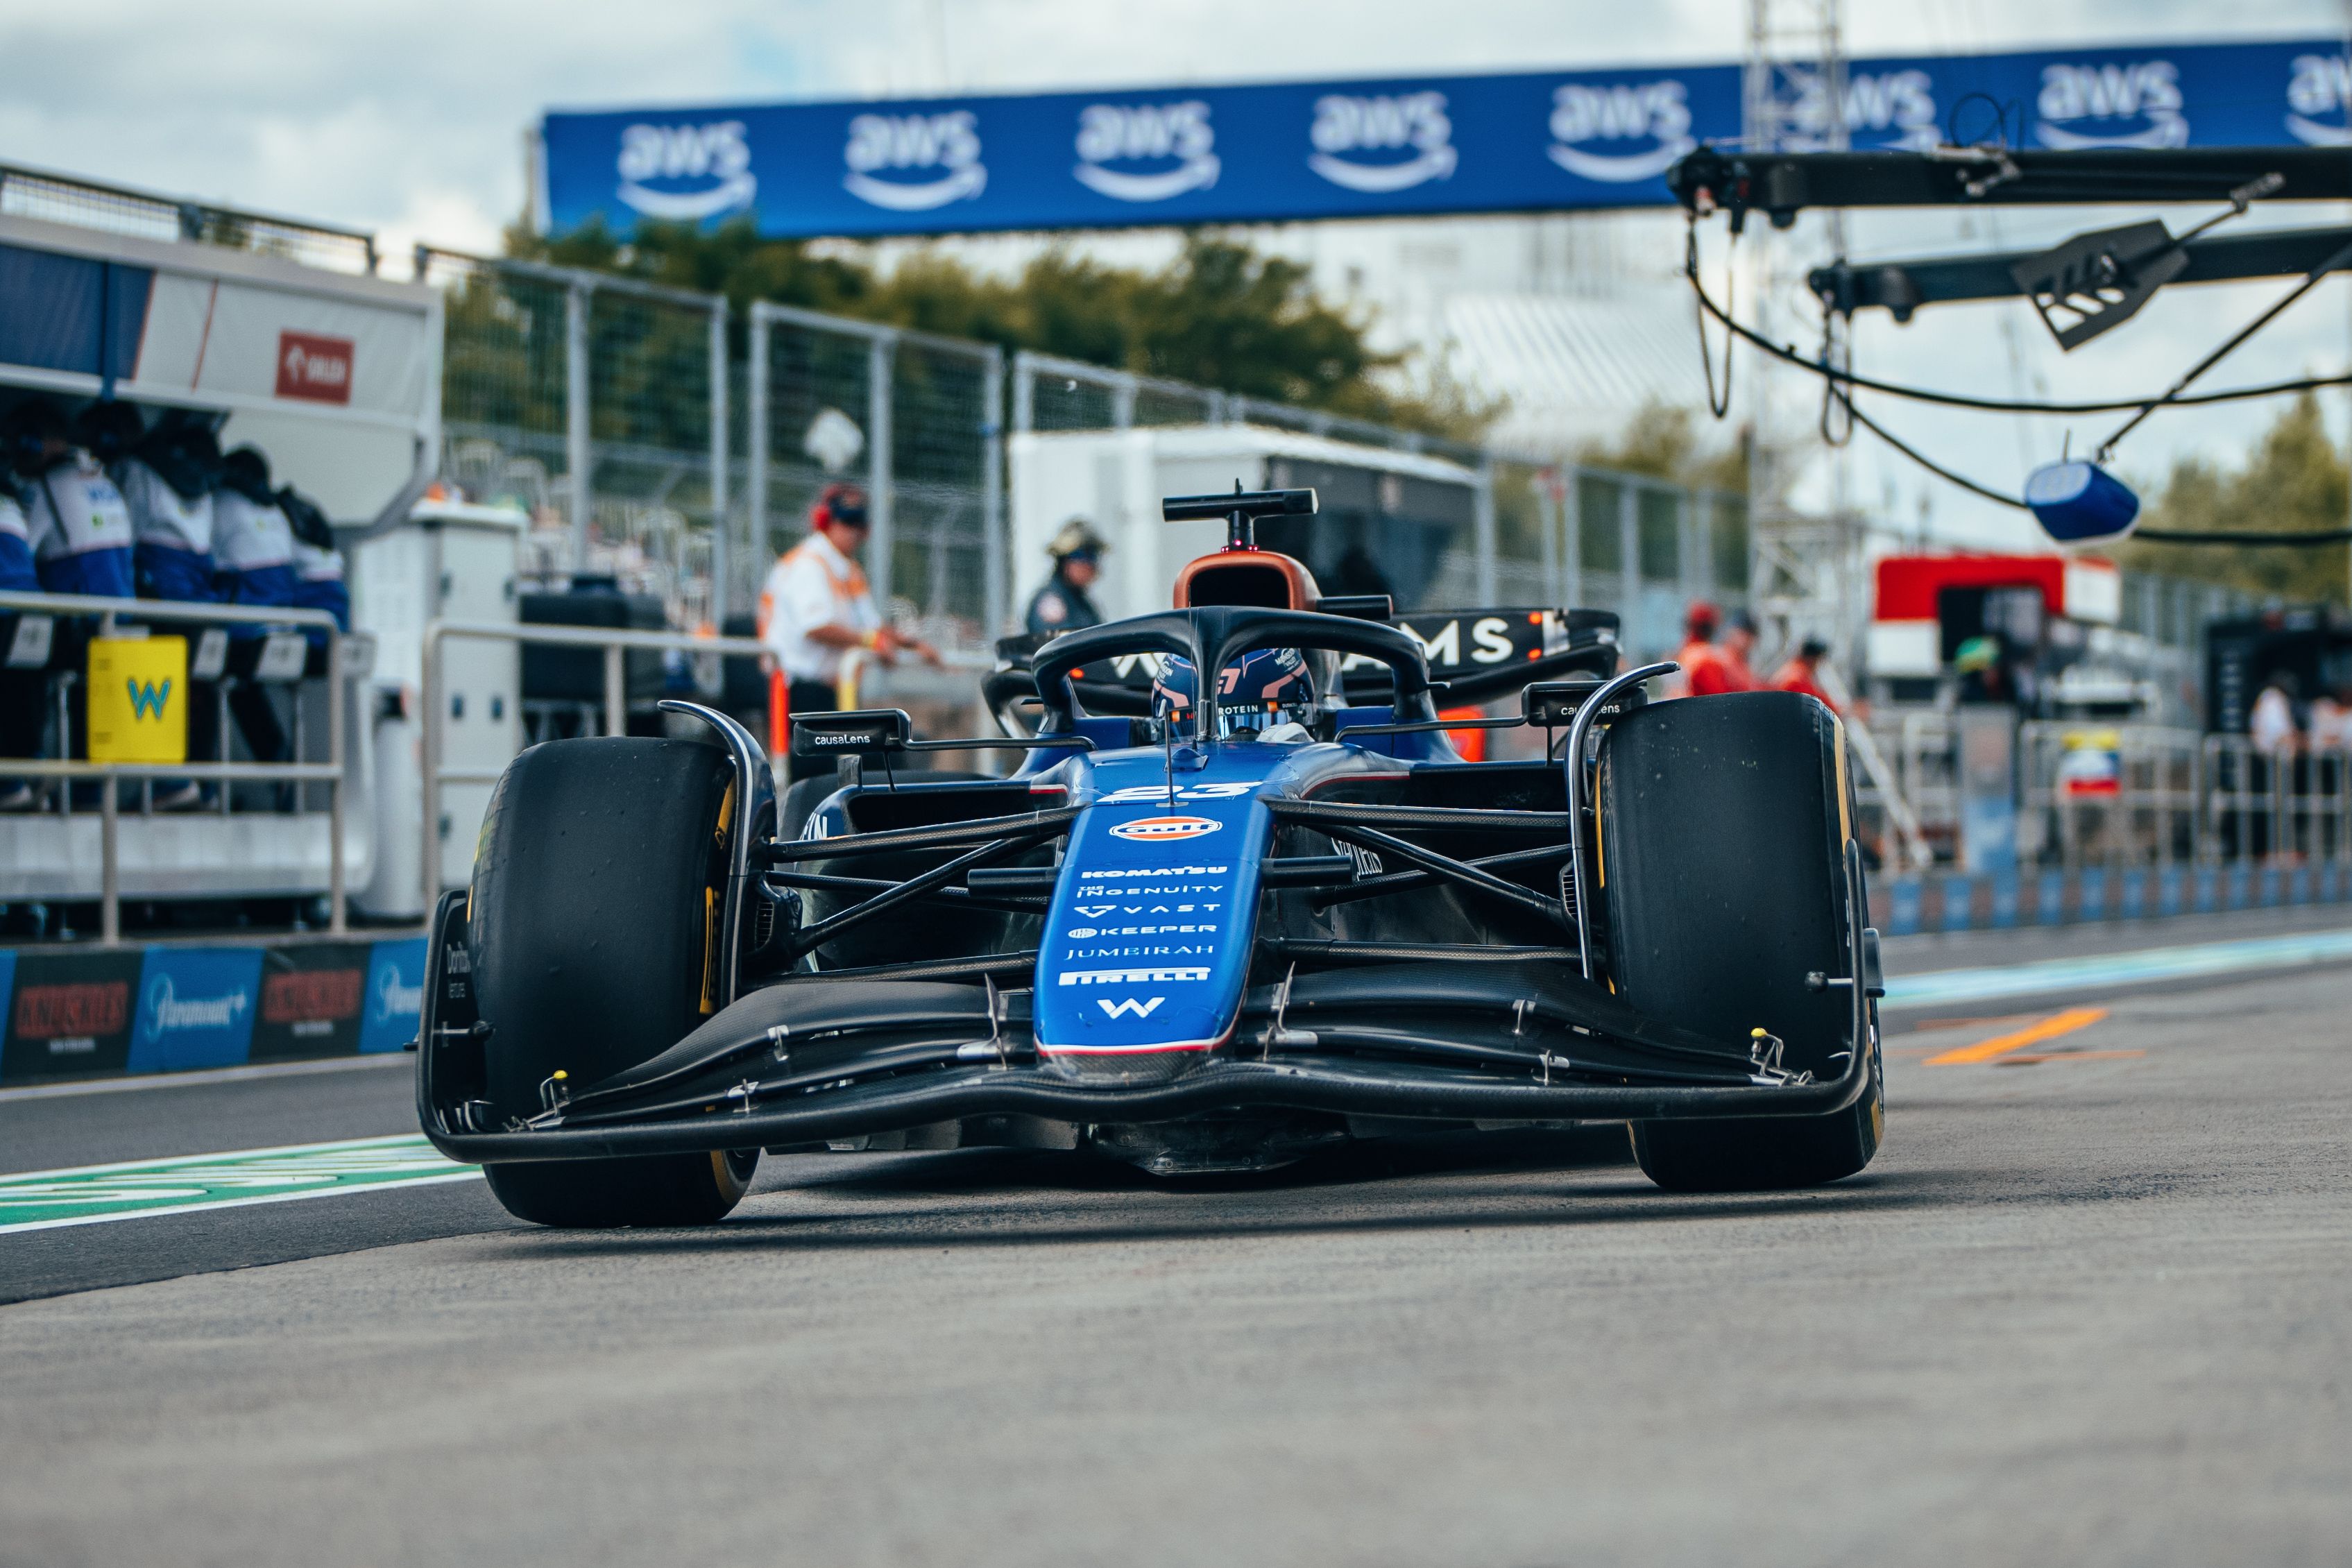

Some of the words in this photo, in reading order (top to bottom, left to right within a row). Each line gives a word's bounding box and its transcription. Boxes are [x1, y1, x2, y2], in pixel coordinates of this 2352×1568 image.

[2036, 60, 2183, 120] aws
[1311, 91, 1451, 151] aws
[1549, 80, 1691, 142] aws
[844, 110, 982, 172] aws
[1075, 101, 1214, 162] aws
[617, 121, 751, 180] aws
[128, 676, 171, 722] W
[1218, 704, 1259, 716] ROTEIN
[815, 734, 871, 745] causaLens
[1096, 782, 1263, 803] 23
[1081, 866, 1228, 879] KOMATSU
[1077, 885, 1224, 898] INGENUITY
[1123, 903, 1222, 914] VAST
[1100, 924, 1218, 937] KEEPER
[1063, 944, 1214, 961] JUMEIRAH
[1058, 966, 1211, 987] PIRELLI
